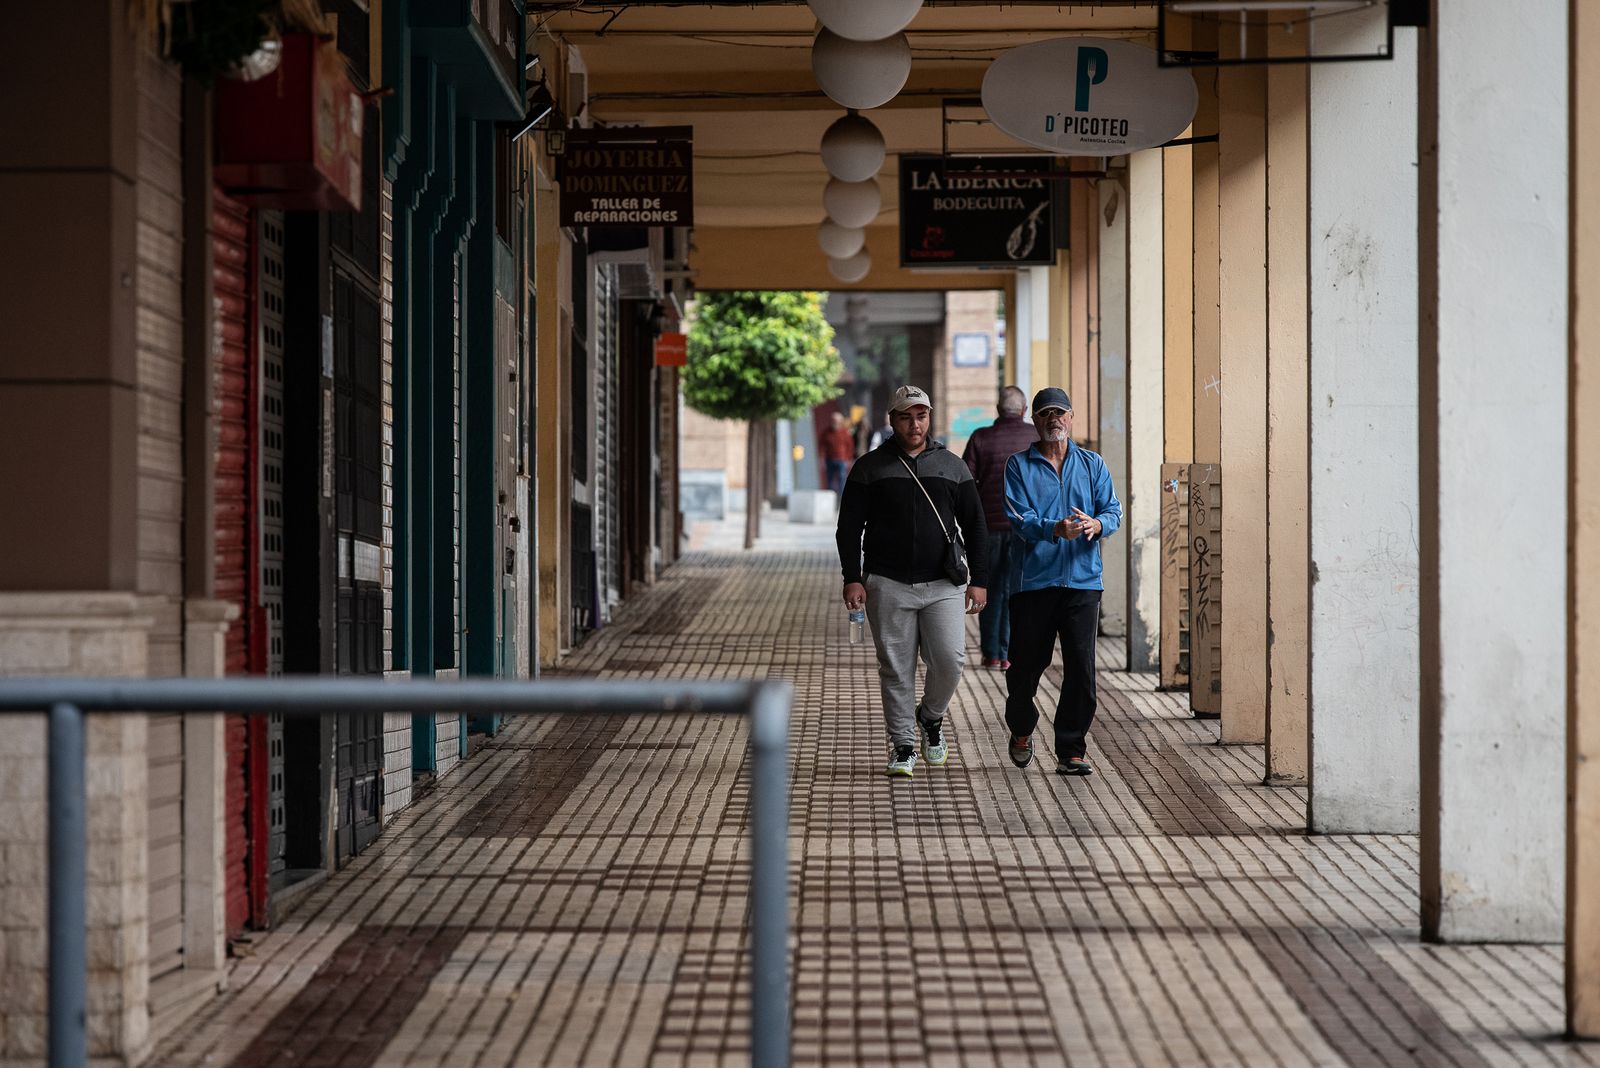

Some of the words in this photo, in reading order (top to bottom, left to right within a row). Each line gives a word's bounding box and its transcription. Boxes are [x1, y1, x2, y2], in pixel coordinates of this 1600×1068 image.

[1064, 116, 1129, 137] PICOTEO
[566, 175, 688, 193] DOMINGUEZ
[911, 171, 941, 190] LA
[591, 198, 639, 209] TALLER
[643, 198, 661, 209] DE
[932, 197, 1025, 210] BODEGUITA
[574, 211, 678, 222] REPARACIONES
